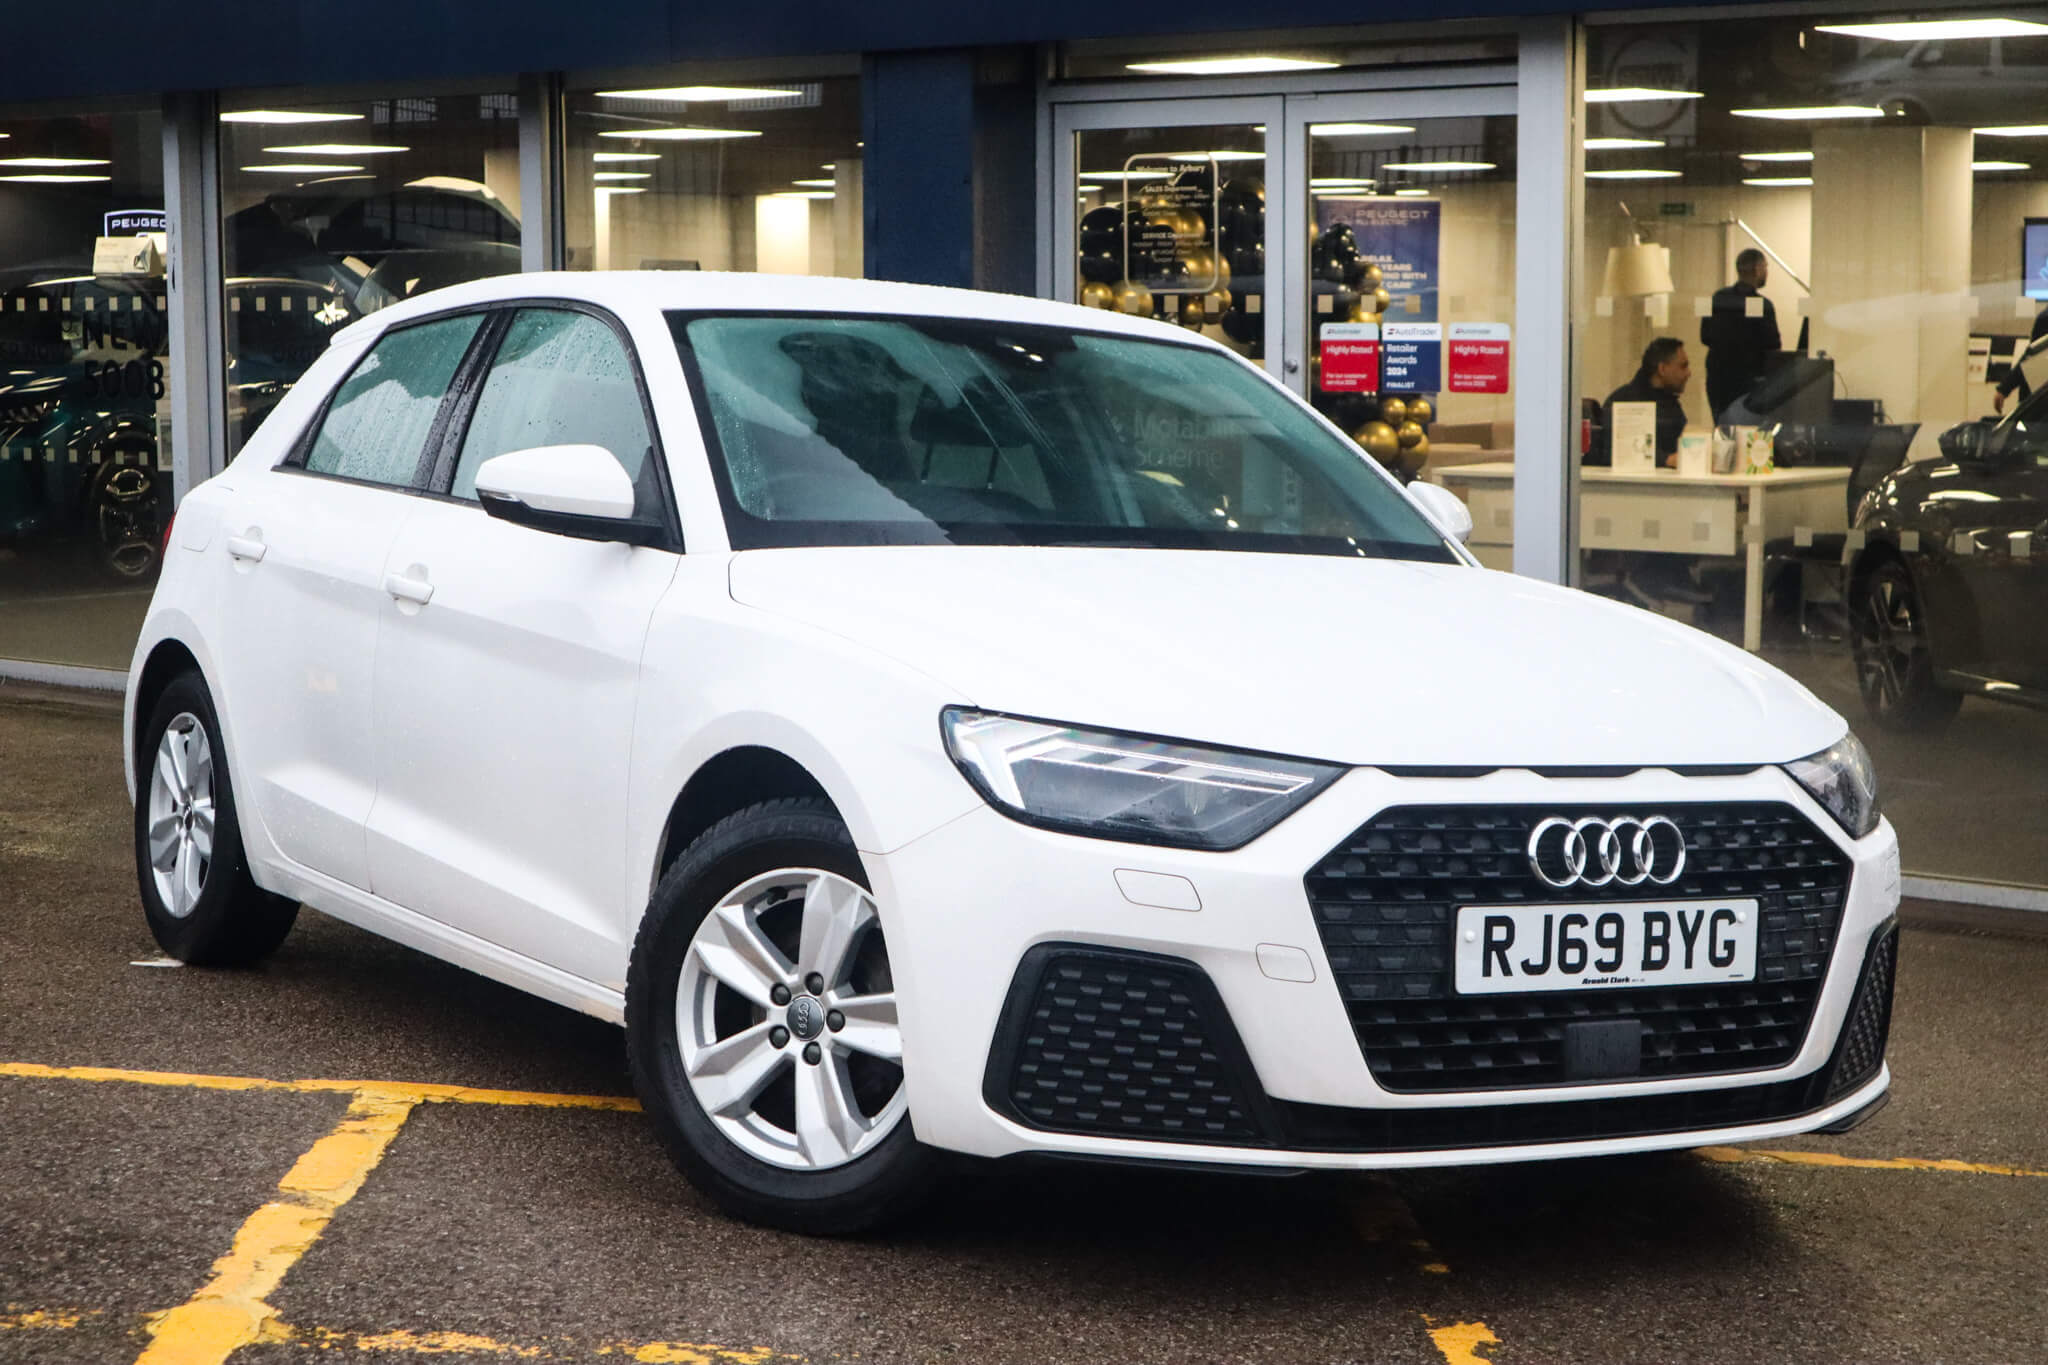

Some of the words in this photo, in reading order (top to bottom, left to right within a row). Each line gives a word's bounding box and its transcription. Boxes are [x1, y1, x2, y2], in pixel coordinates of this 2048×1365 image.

[1355, 209, 1430, 219] PEUGEOT
[1326, 345, 1350, 356] Highly
[1351, 345, 1374, 354] Rated
[1386, 343, 1418, 353] Retailer
[1454, 345, 1479, 356] Highly
[1480, 346, 1504, 355] Rated
[1386, 355, 1418, 365] Awards
[84, 359, 165, 400] 5008
[1482, 912, 1625, 977] RJ69
[1641, 908, 1737, 972] BYG
[1582, 977, 1609, 985] Arnold
[1610, 976, 1631, 984] Clark
